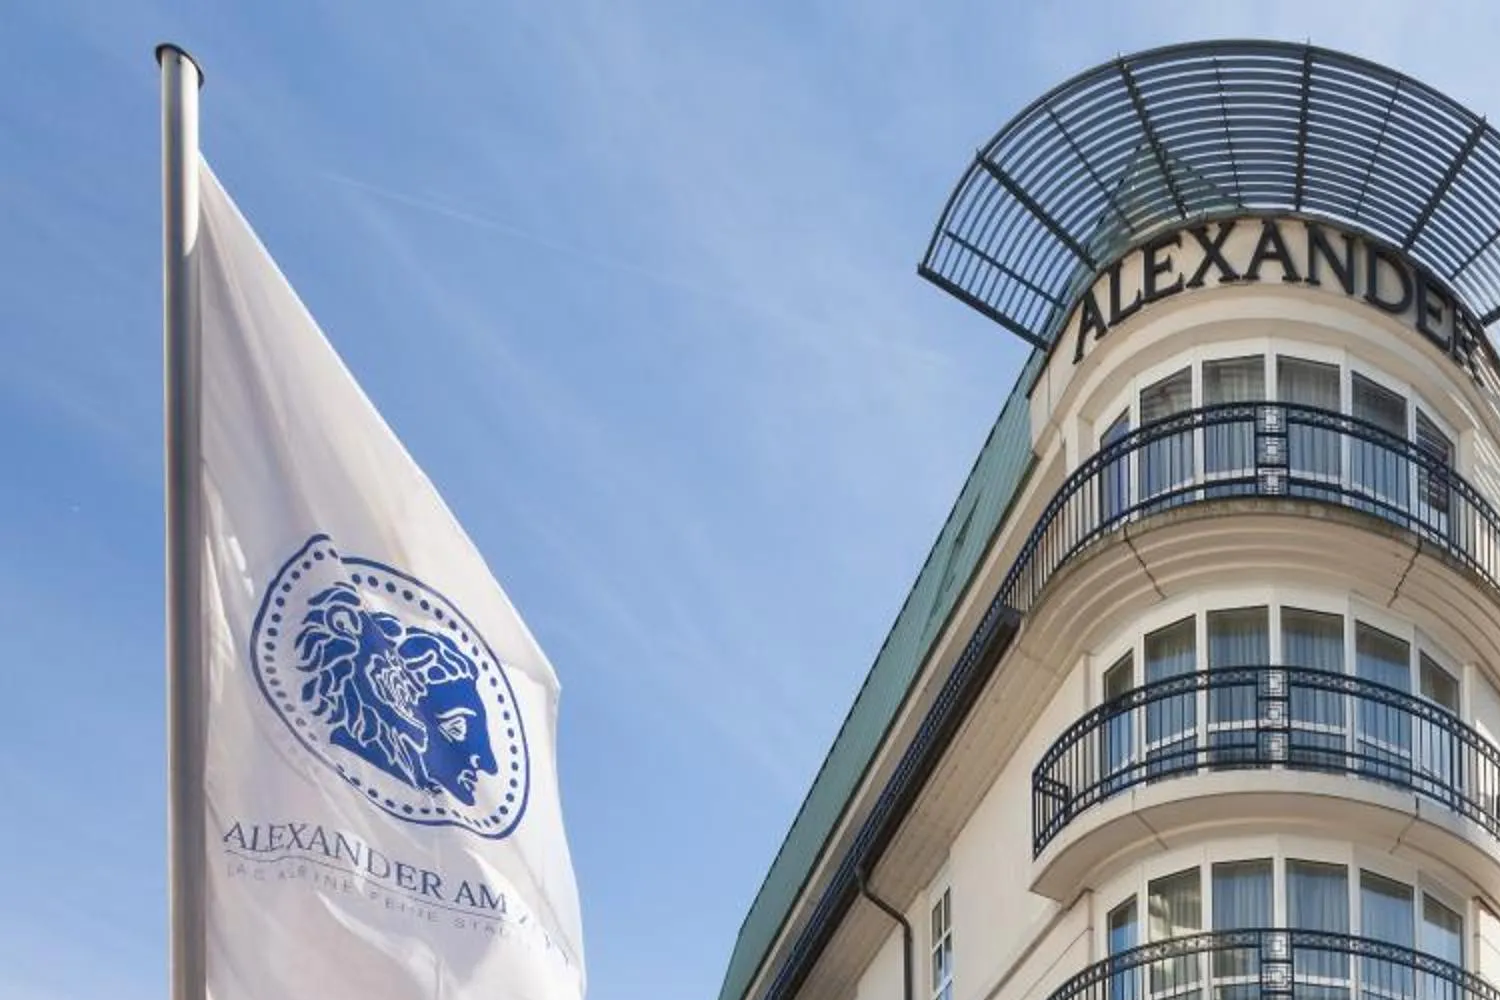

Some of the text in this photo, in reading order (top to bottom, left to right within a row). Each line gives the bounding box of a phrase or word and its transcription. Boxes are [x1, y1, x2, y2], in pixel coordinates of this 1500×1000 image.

[1072, 219, 1484, 386] ALEXANDER
[223, 821, 507, 914] ALEXANDER AM
